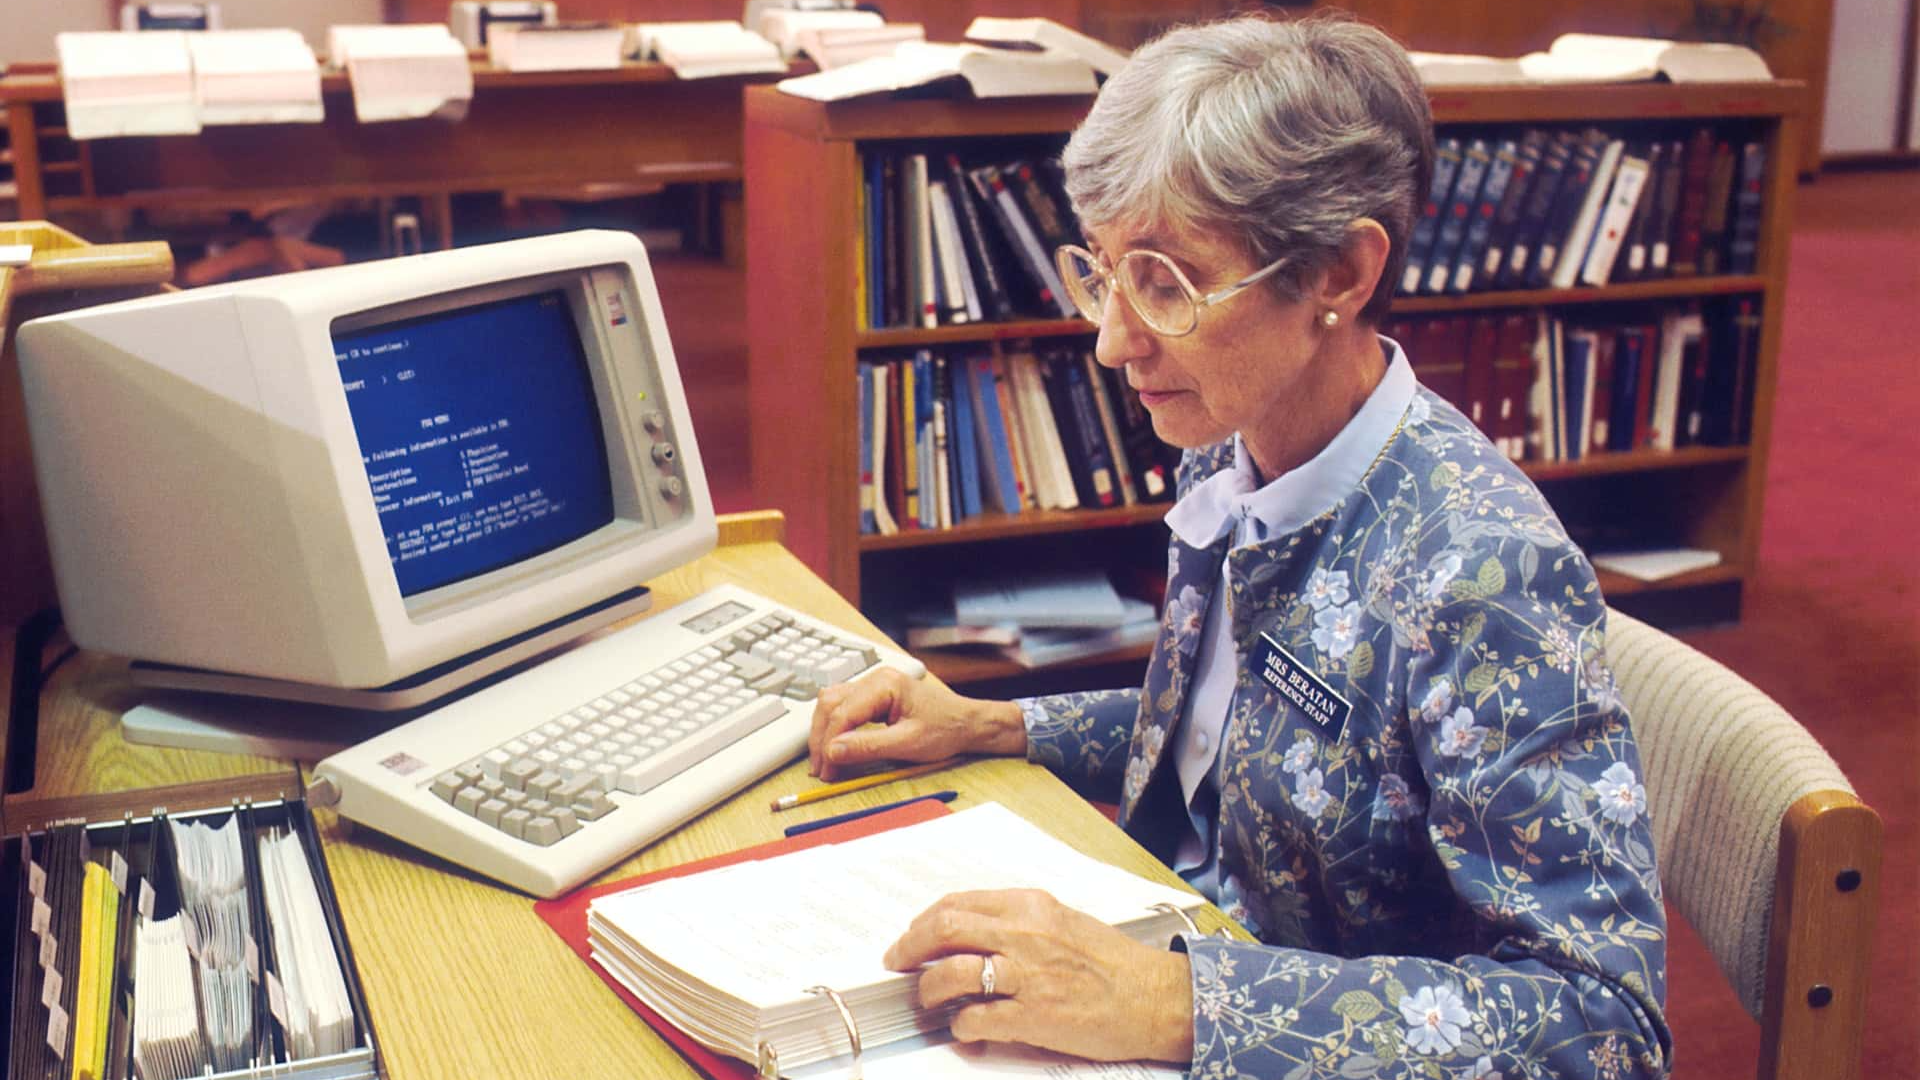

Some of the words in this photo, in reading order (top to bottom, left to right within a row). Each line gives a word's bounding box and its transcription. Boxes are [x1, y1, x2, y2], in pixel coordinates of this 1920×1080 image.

[362, 348, 371, 356] to
[373, 448, 407, 461] following
[409, 436, 448, 453] information
[450, 433, 458, 441] is
[460, 425, 488, 439] available
[370, 467, 412, 483] Description
[373, 476, 417, 493] Instructions
[403, 490, 442, 507] Information
[446, 494, 460, 506] Exit
[435, 517, 457, 531] prompt
[430, 540, 451, 553] number
[1265, 651, 1288, 676] MRS
[1288, 670, 1337, 716] BERATAN
[1263, 667, 1305, 707] REFERENCE
[1304, 702, 1330, 726] STAFF
